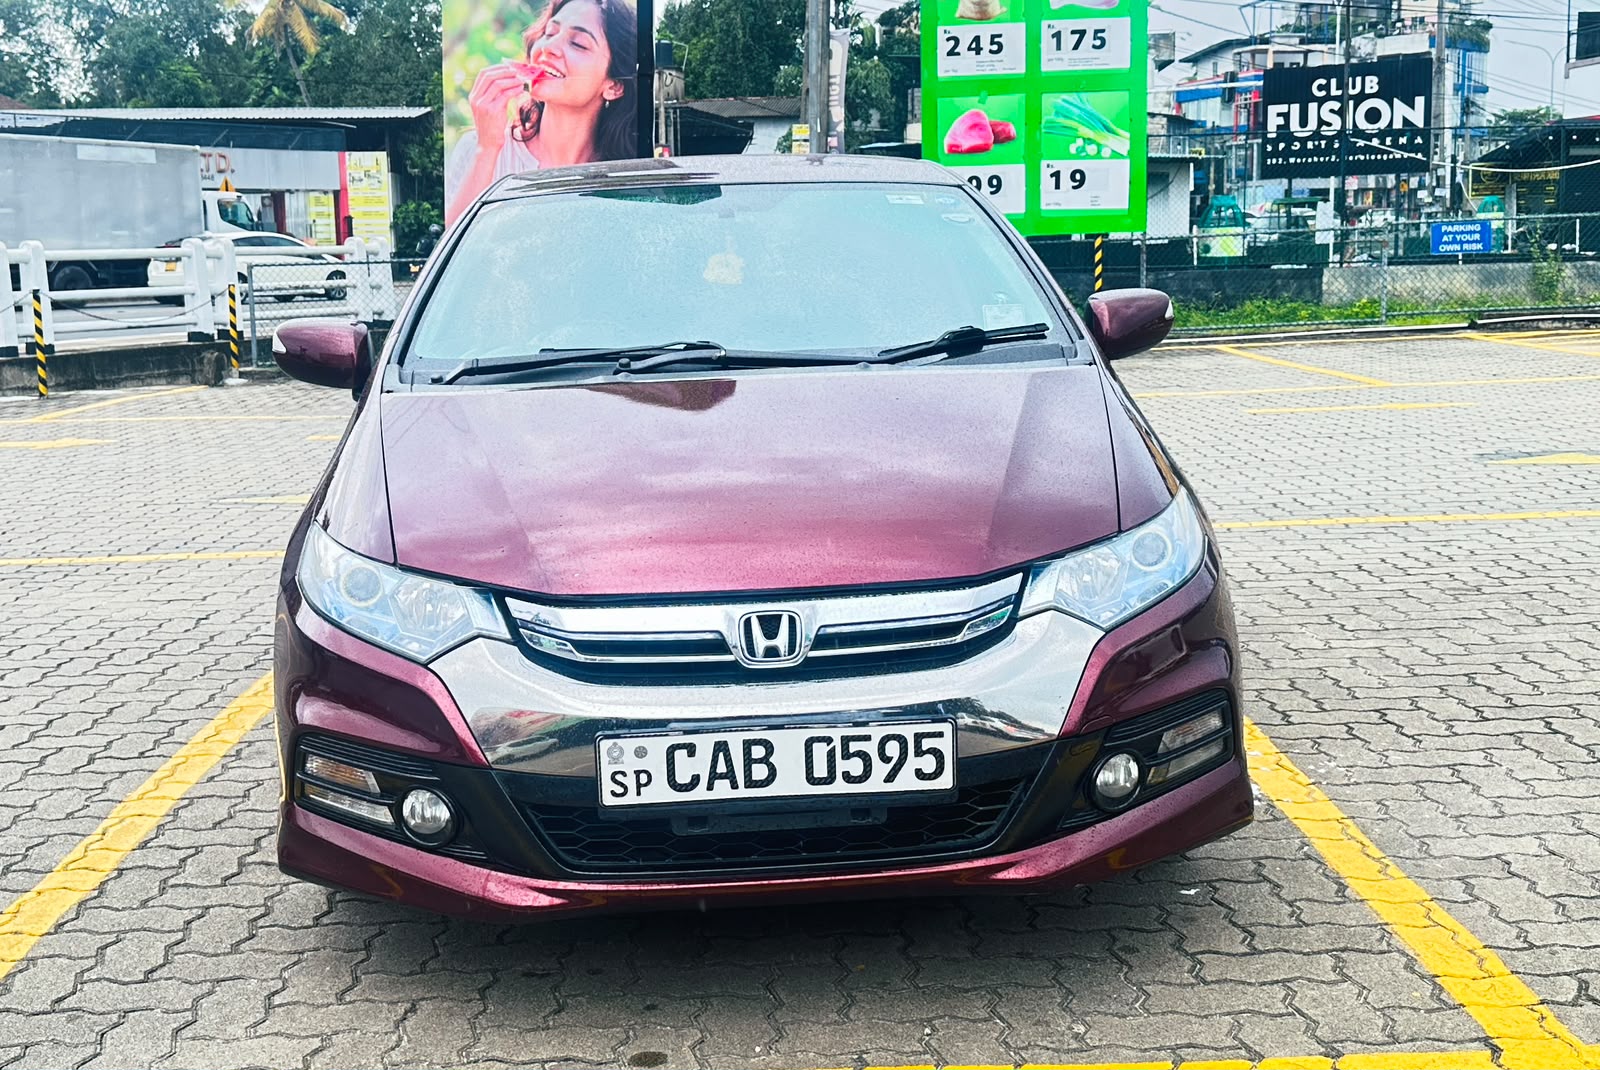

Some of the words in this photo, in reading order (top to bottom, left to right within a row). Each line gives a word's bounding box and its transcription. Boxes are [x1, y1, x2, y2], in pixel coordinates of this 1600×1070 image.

[945, 33, 1004, 57] 245
[1051, 28, 1107, 51] 175
[1311, 75, 1379, 97] CLUB
[1266, 96, 1425, 138] FUSION
[1266, 139, 1340, 152] SPORTS
[200, 152, 235, 174] TD.
[1049, 168, 1087, 190] 19
[1441, 223, 1481, 233] PARKING
[1442, 234, 1454, 242] AT
[1455, 233, 1481, 242] YOUR
[1438, 243, 1461, 252] OWN
[1462, 242, 1484, 252] RISK
[610, 769, 653, 799] SP
[665, 738, 779, 793] CAB
[803, 731, 946, 787] 0595
